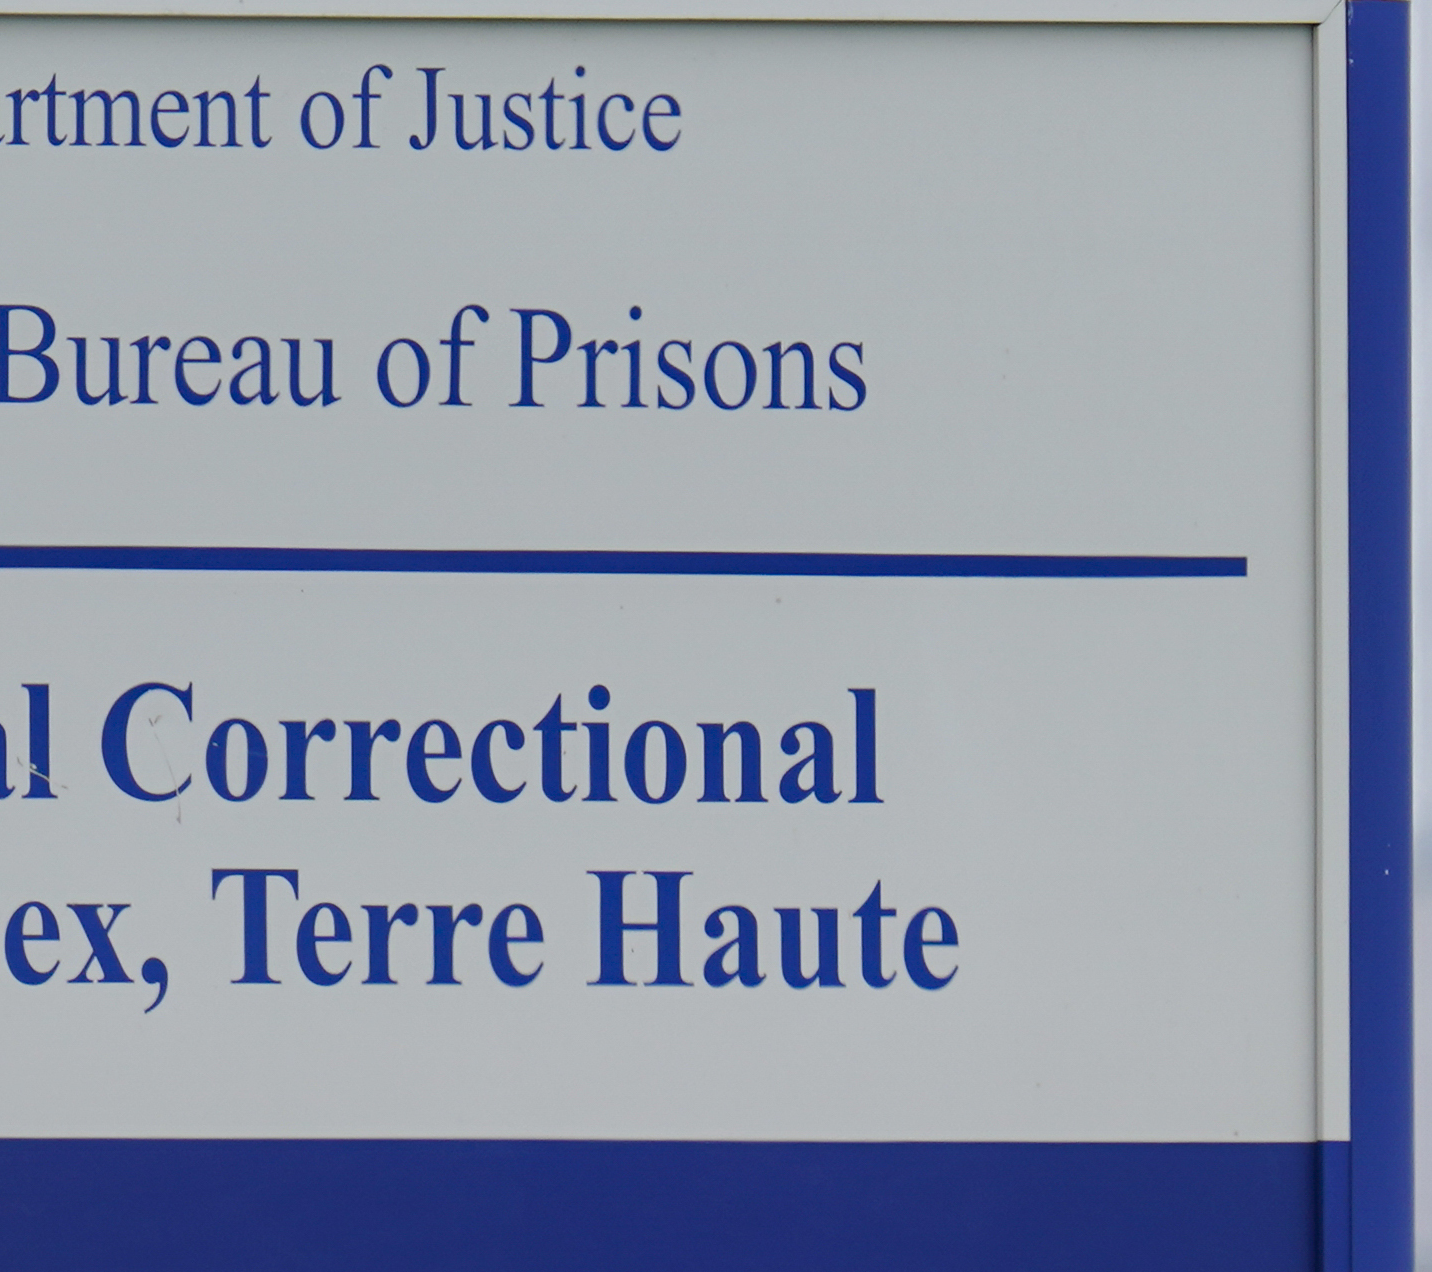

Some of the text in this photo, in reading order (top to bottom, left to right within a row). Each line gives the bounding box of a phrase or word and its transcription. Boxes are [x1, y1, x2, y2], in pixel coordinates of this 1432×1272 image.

[298, 64, 395, 152] of
[407, 66, 683, 154] Justice
[375, 304, 491, 411] of
[507, 306, 868, 414] Prisons
[99, 681, 885, 807] Correctional
[209, 868, 545, 990] Terre
[585, 869, 961, 993] Haute
